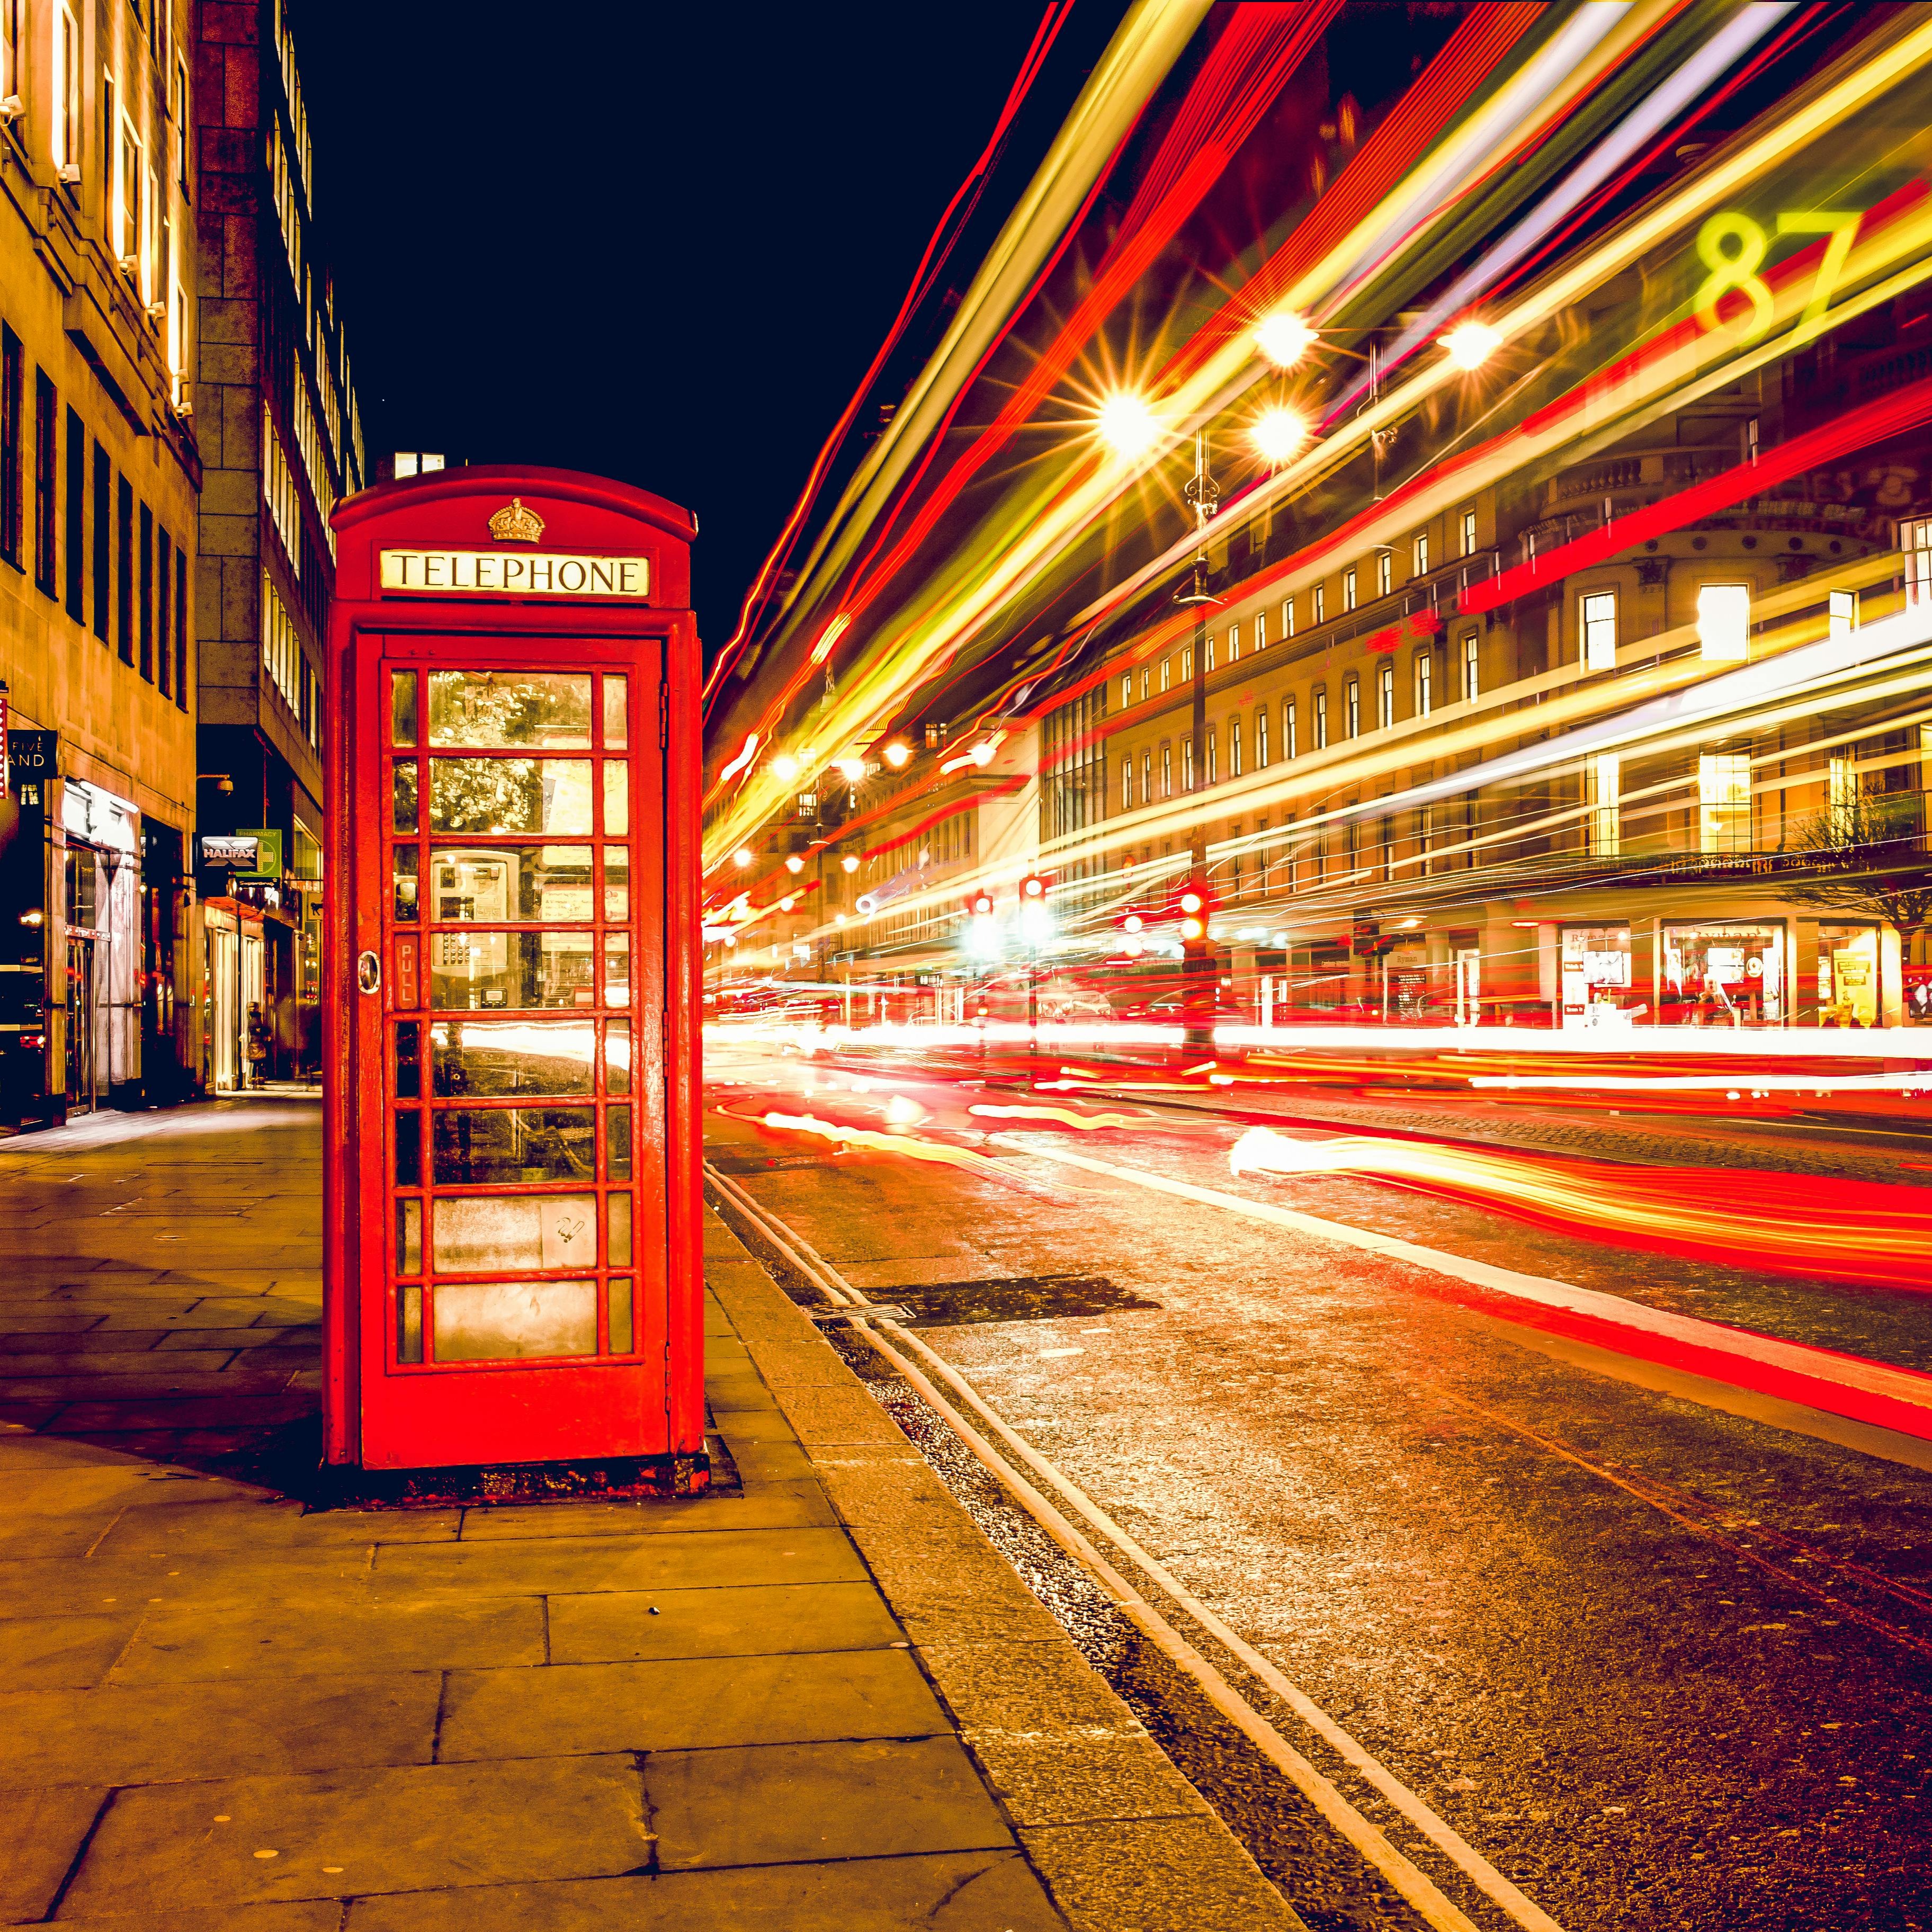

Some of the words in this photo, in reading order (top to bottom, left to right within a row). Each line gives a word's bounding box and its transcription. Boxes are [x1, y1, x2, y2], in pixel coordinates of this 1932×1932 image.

[1695, 211, 1862, 347] 87
[392, 555, 638, 592] TELEPHONE
[13, 742, 43, 751] FIVE
[203, 848, 255, 858] HALIFAX
[1397, 955, 1418, 964] Ryman
[402, 945, 412, 1001] PULL
